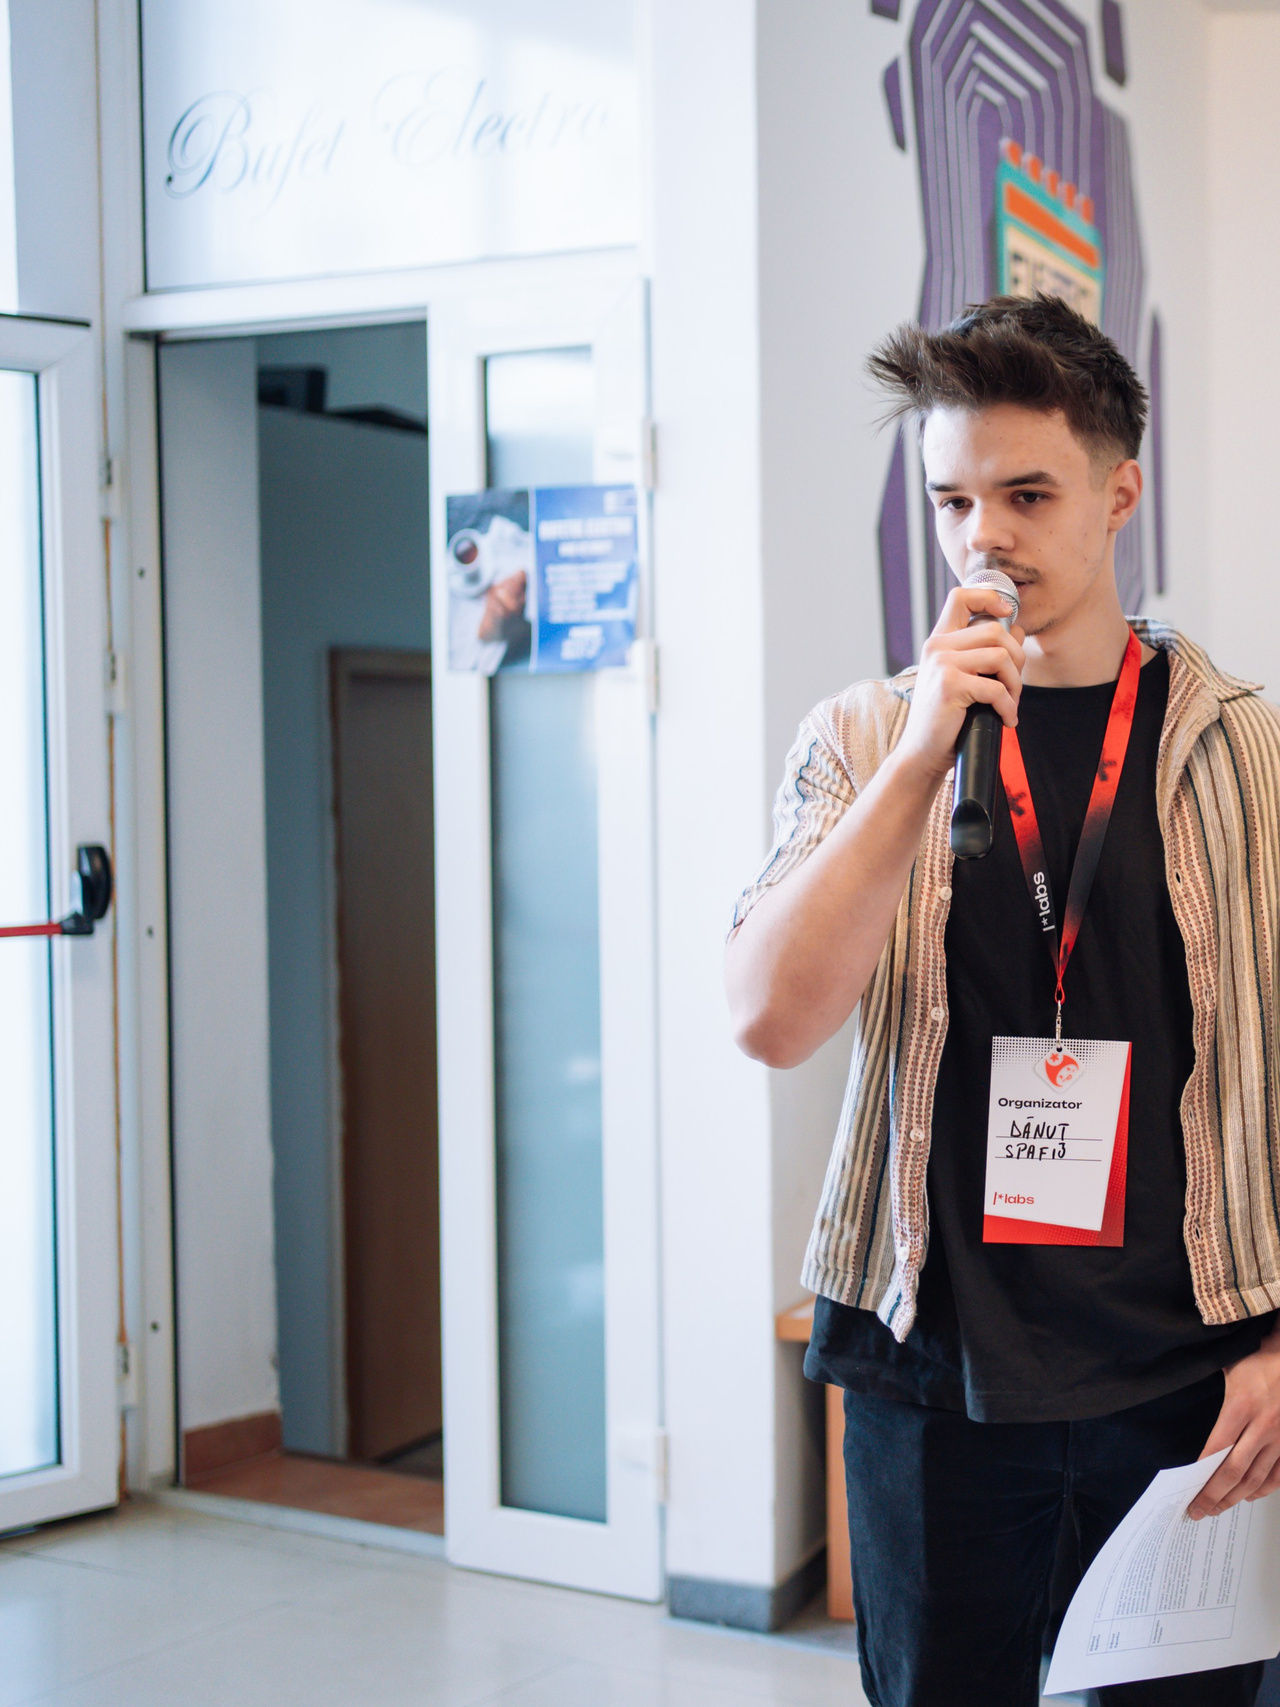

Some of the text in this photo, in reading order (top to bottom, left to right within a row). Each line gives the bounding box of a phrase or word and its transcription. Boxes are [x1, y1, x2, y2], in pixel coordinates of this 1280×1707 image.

[164, 65, 611, 224] Bufet Electro
[998, 1097, 1082, 1109] Organizator
